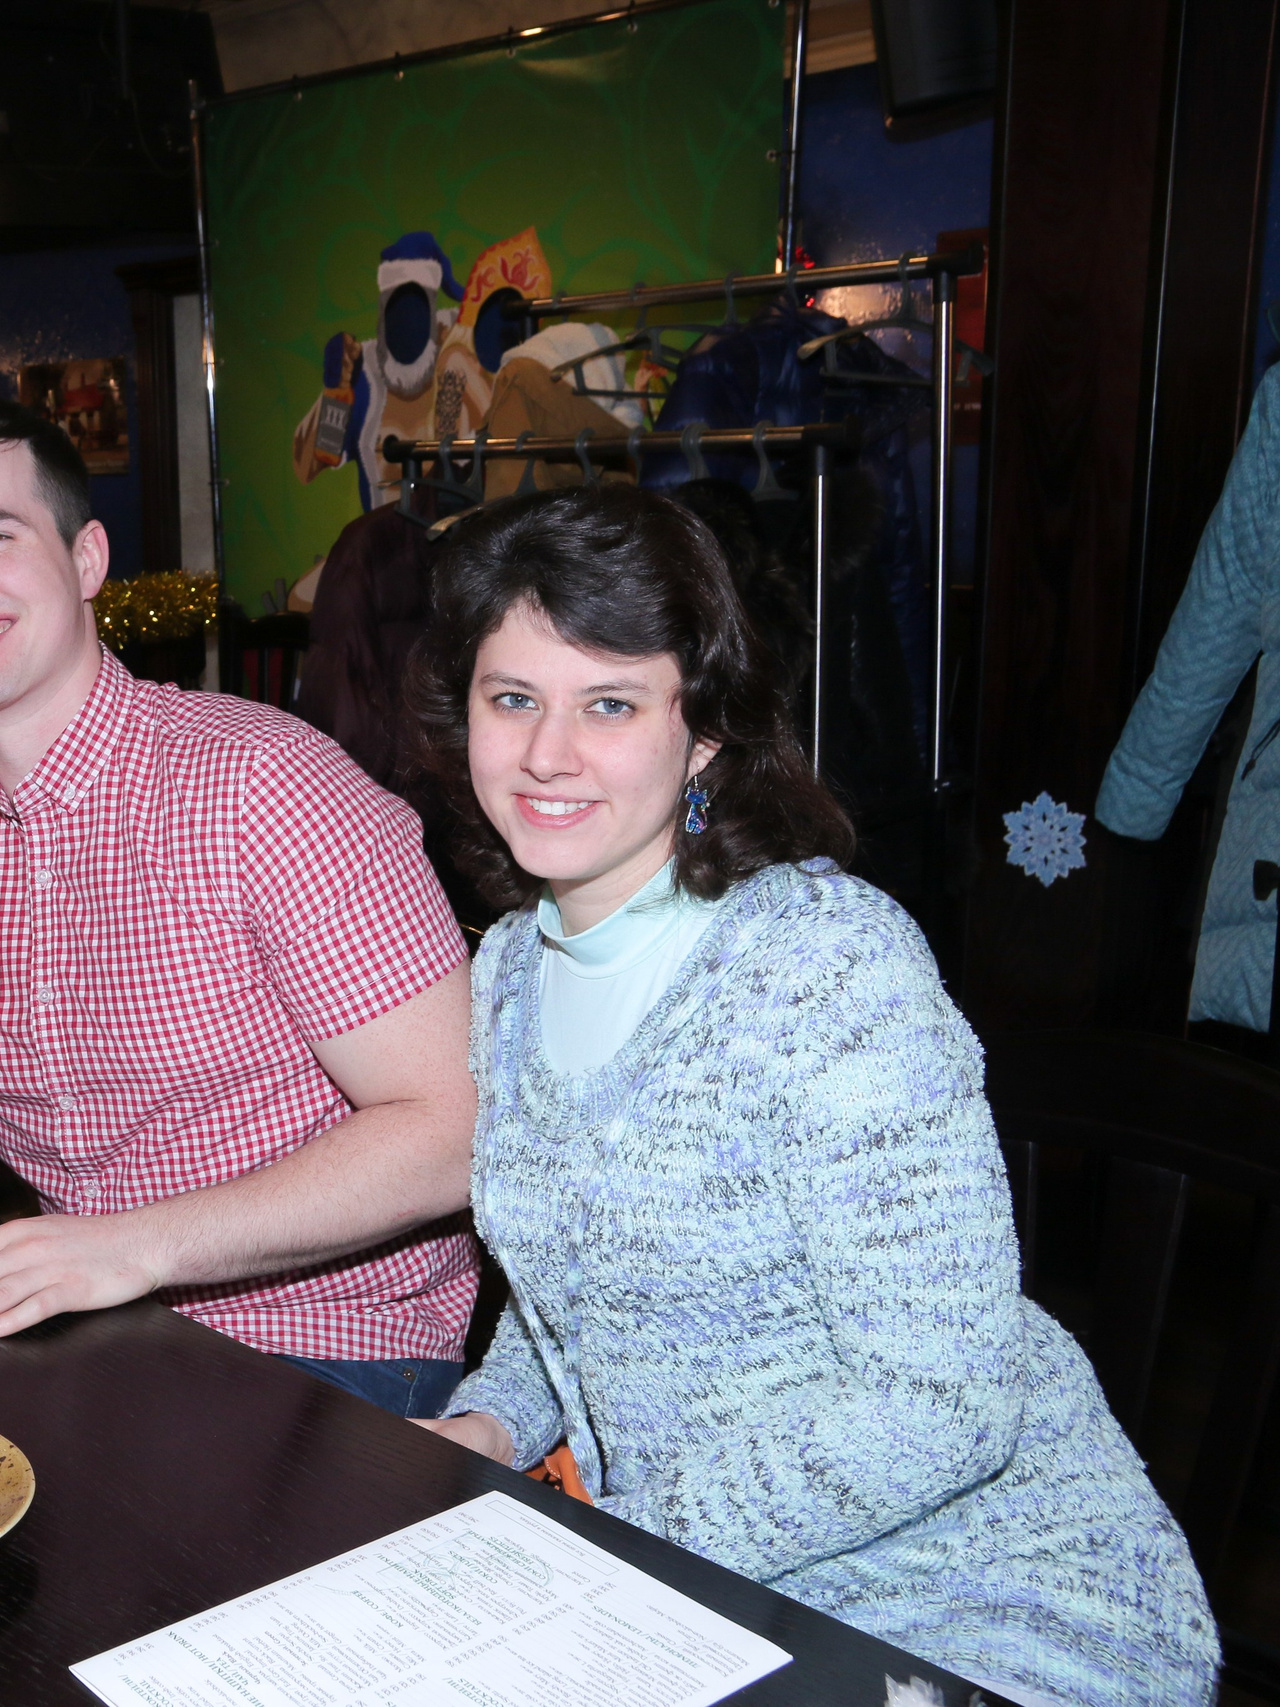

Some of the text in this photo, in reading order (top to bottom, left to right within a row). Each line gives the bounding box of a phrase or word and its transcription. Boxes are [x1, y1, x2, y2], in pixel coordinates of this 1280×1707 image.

[350, 1590, 403, 1628] КОФЕ COFFEE
[591, 1605, 641, 1634] LEMONADES
